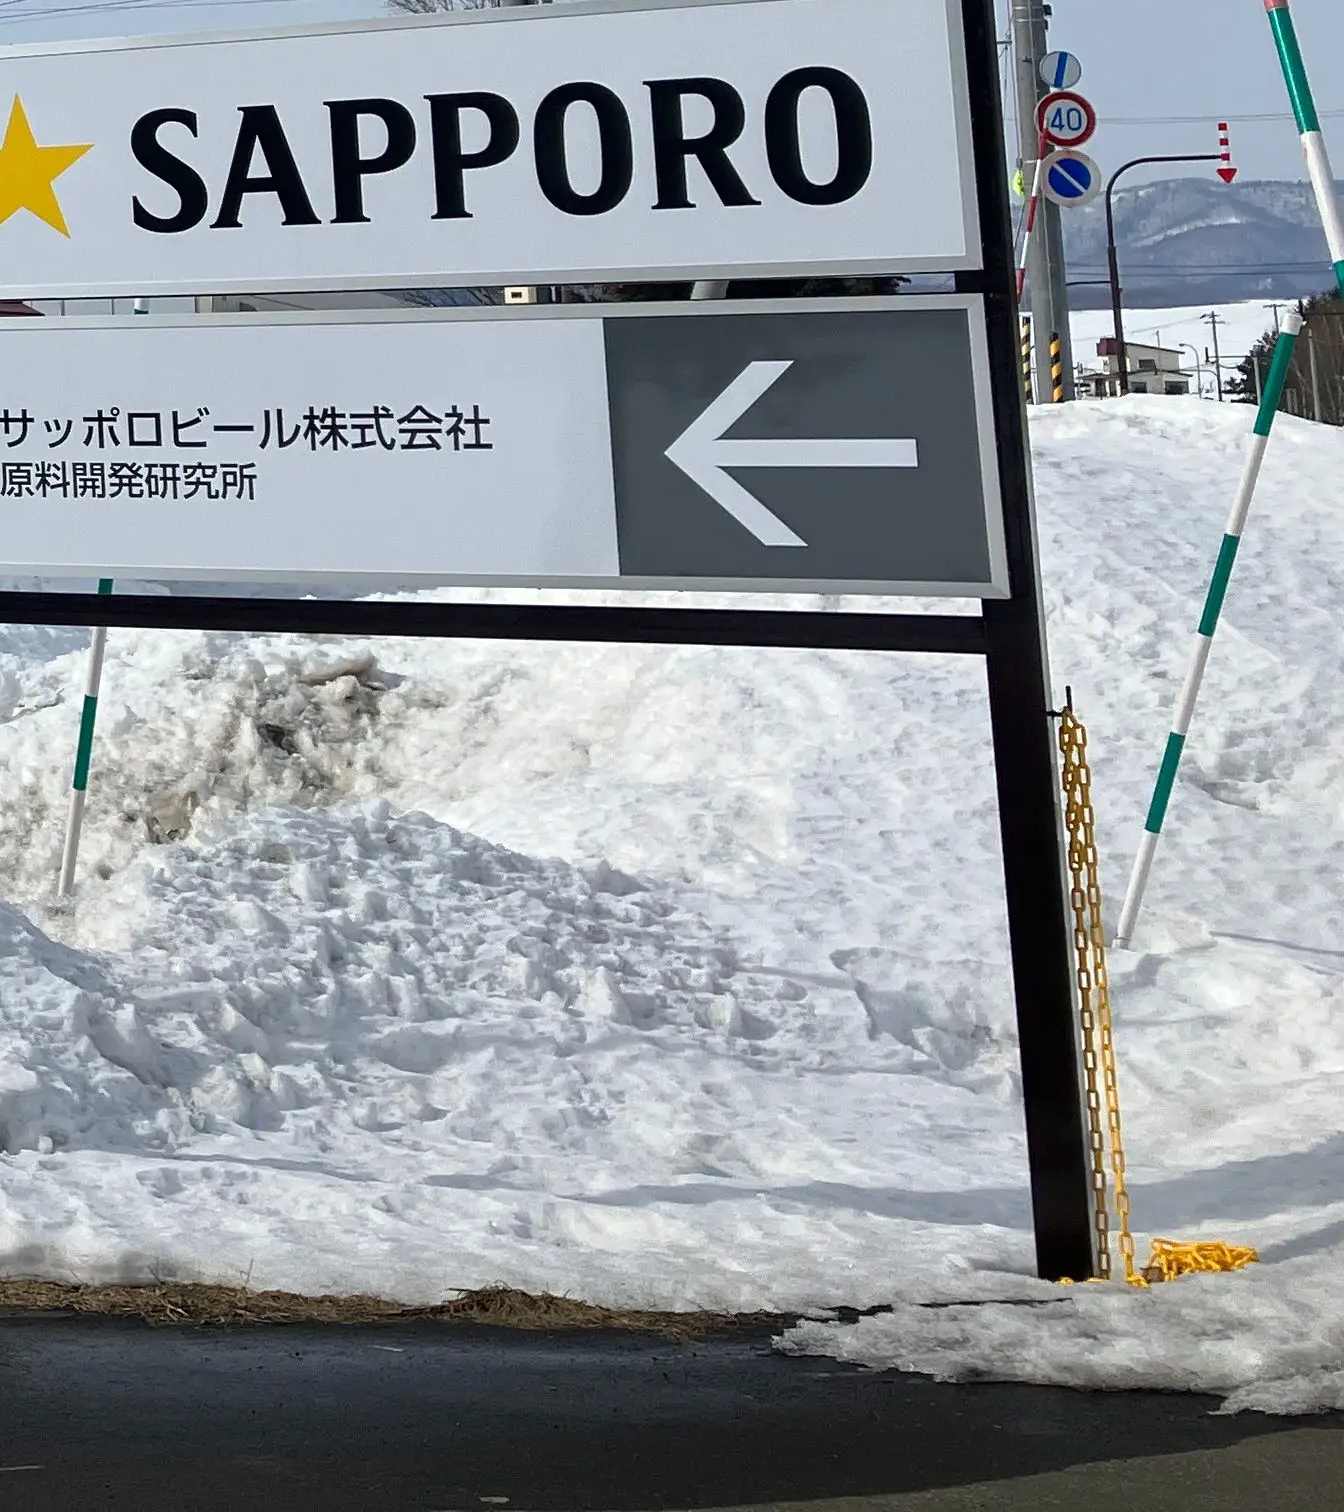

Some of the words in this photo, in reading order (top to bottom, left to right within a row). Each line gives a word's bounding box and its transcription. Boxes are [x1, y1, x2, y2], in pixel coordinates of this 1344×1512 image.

[1050, 107, 1082, 131] 40
[131, 67, 872, 233] SAPPORO
[0, 461, 258, 500] 原料開発研究所
